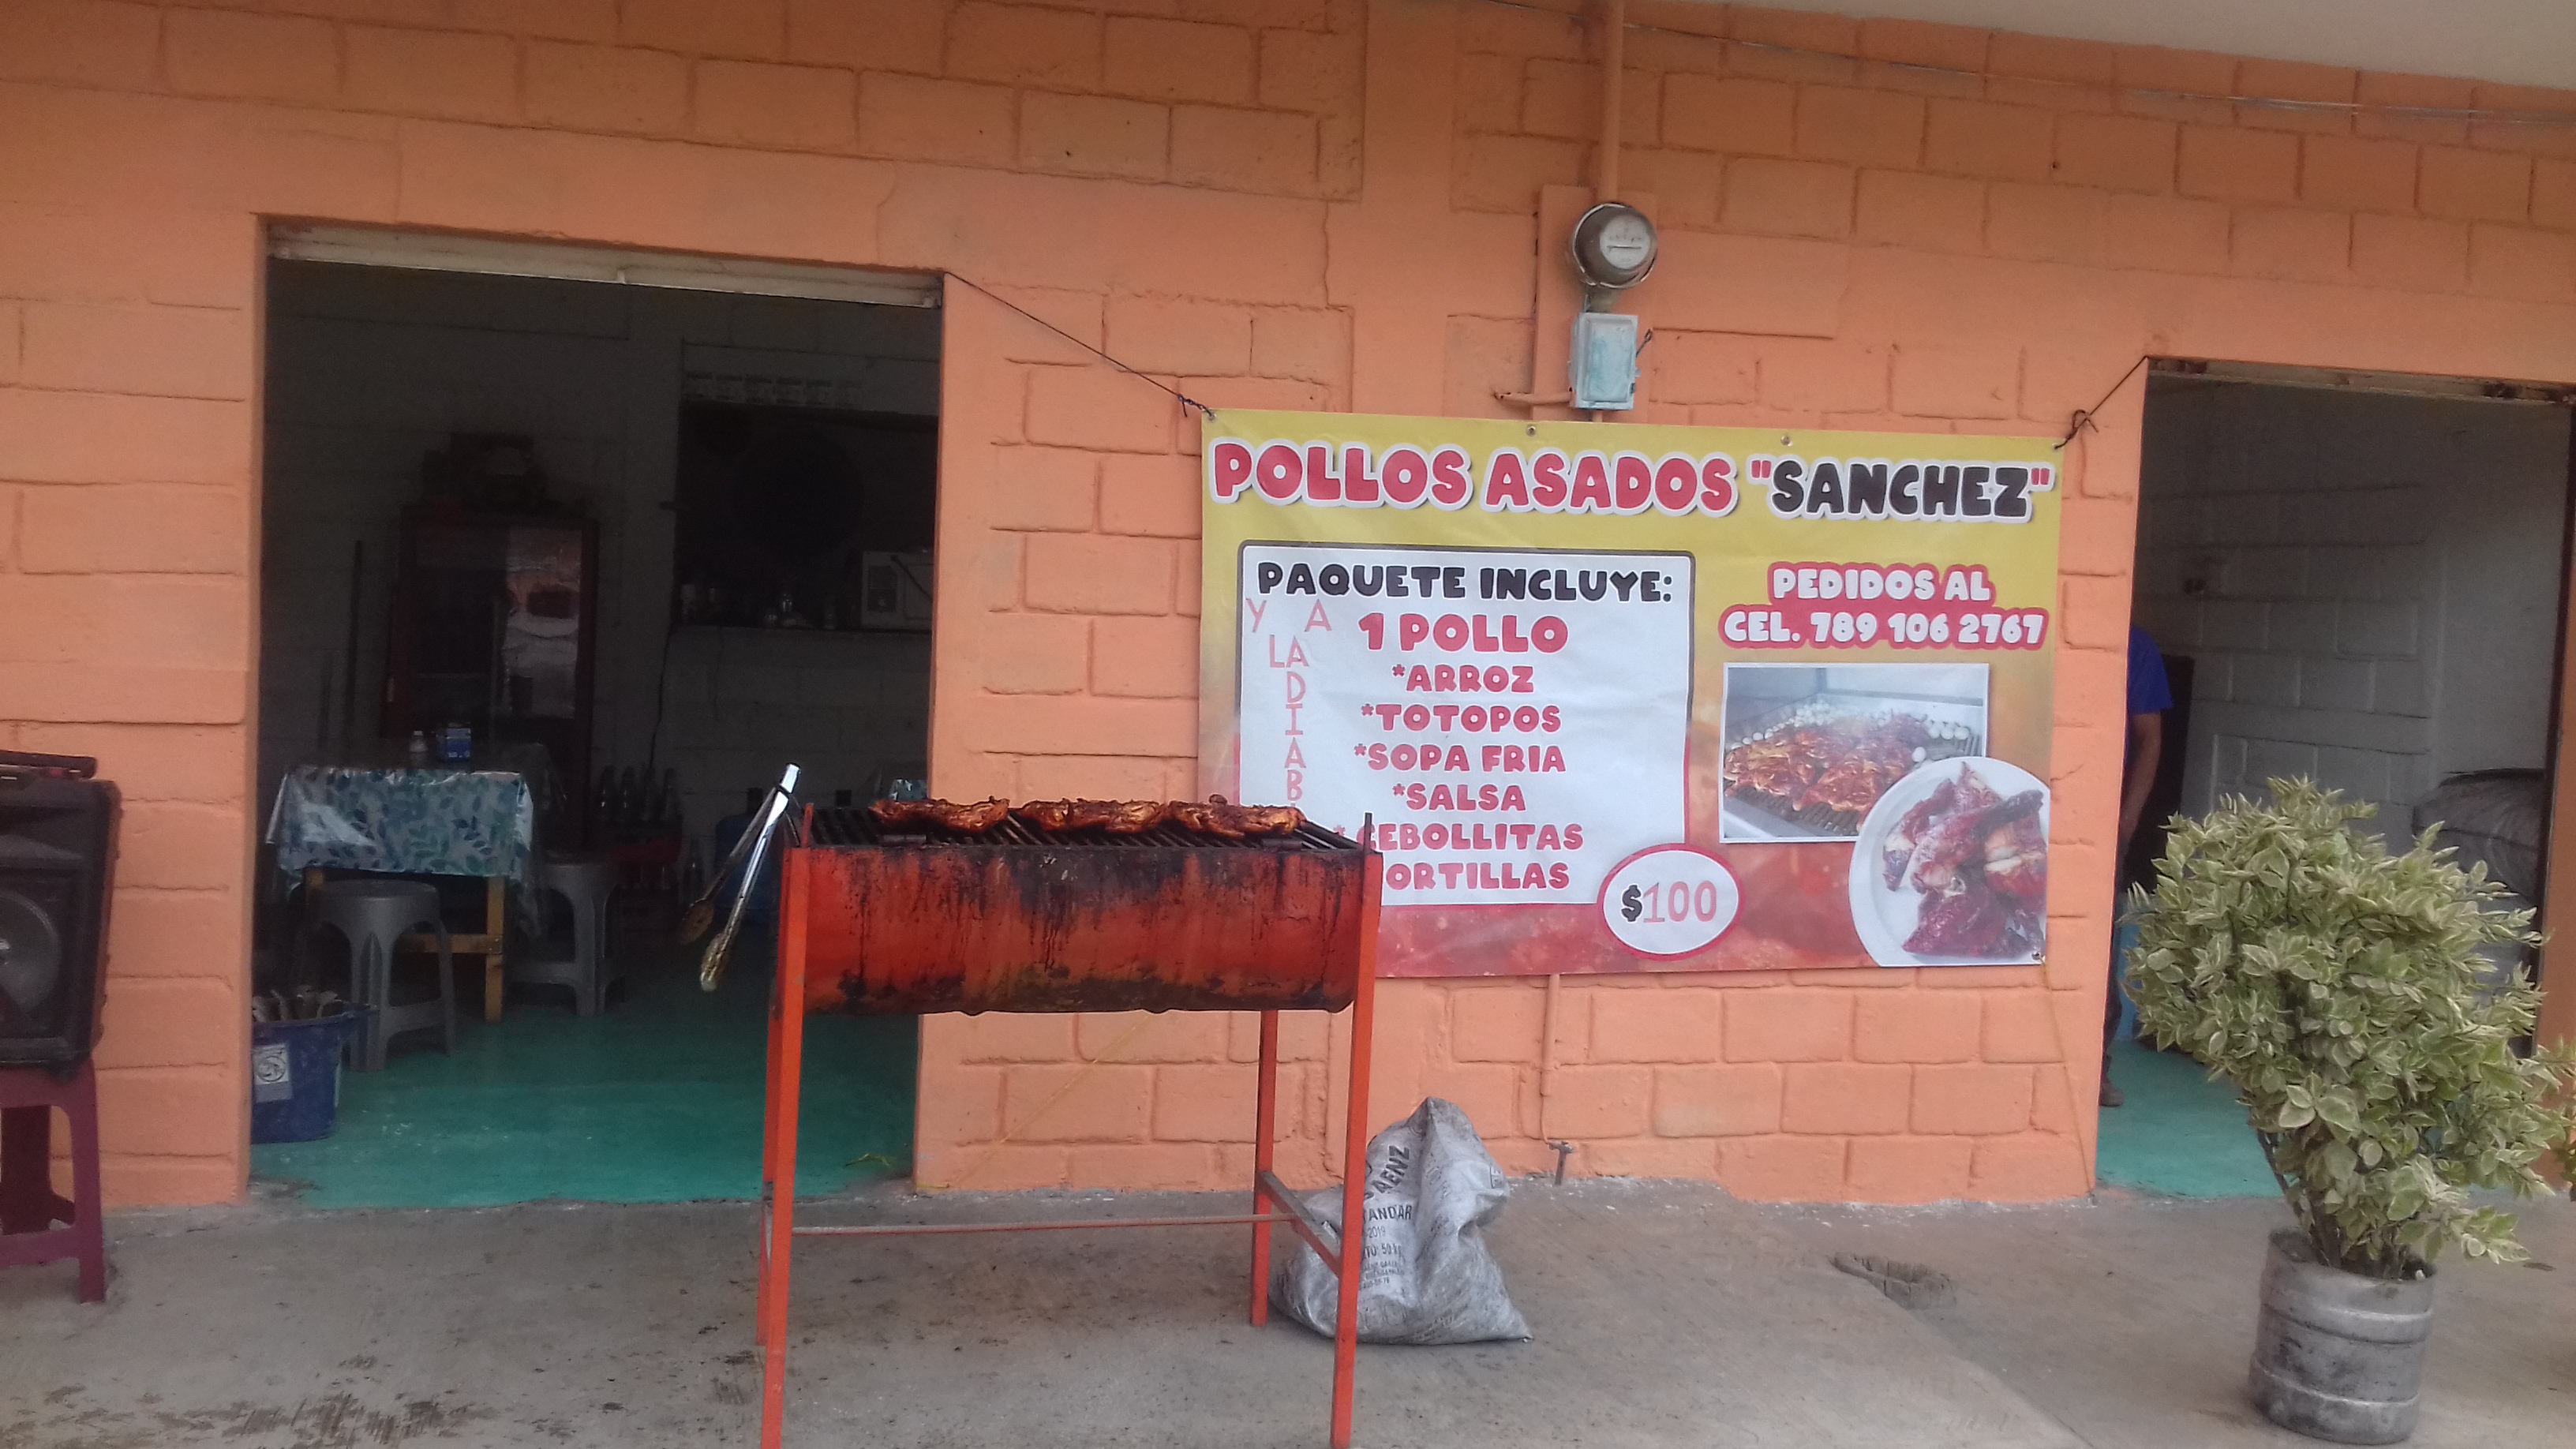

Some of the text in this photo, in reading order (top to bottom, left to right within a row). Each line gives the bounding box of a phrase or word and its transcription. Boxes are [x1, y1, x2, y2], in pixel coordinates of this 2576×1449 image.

[1213, 441, 2050, 518] POLLOS ASADOS "SANCHEZ"
[1257, 562, 1672, 602] PAQUETE INCLUYE:
[1773, 568, 1990, 601] PEDIDOS AL
[1246, 598, 1332, 633] Y A
[1357, 612, 1569, 653] 1 POLLO
[1724, 610, 2044, 645] CEL. 789 106 2767
[1269, 635, 1309, 668] LA
[1284, 671, 1306, 807] DIAB
[1481, 744, 1567, 773] FRIA
[1385, 861, 1571, 890] ORTILLAS
[1620, 880, 1718, 924] $100
